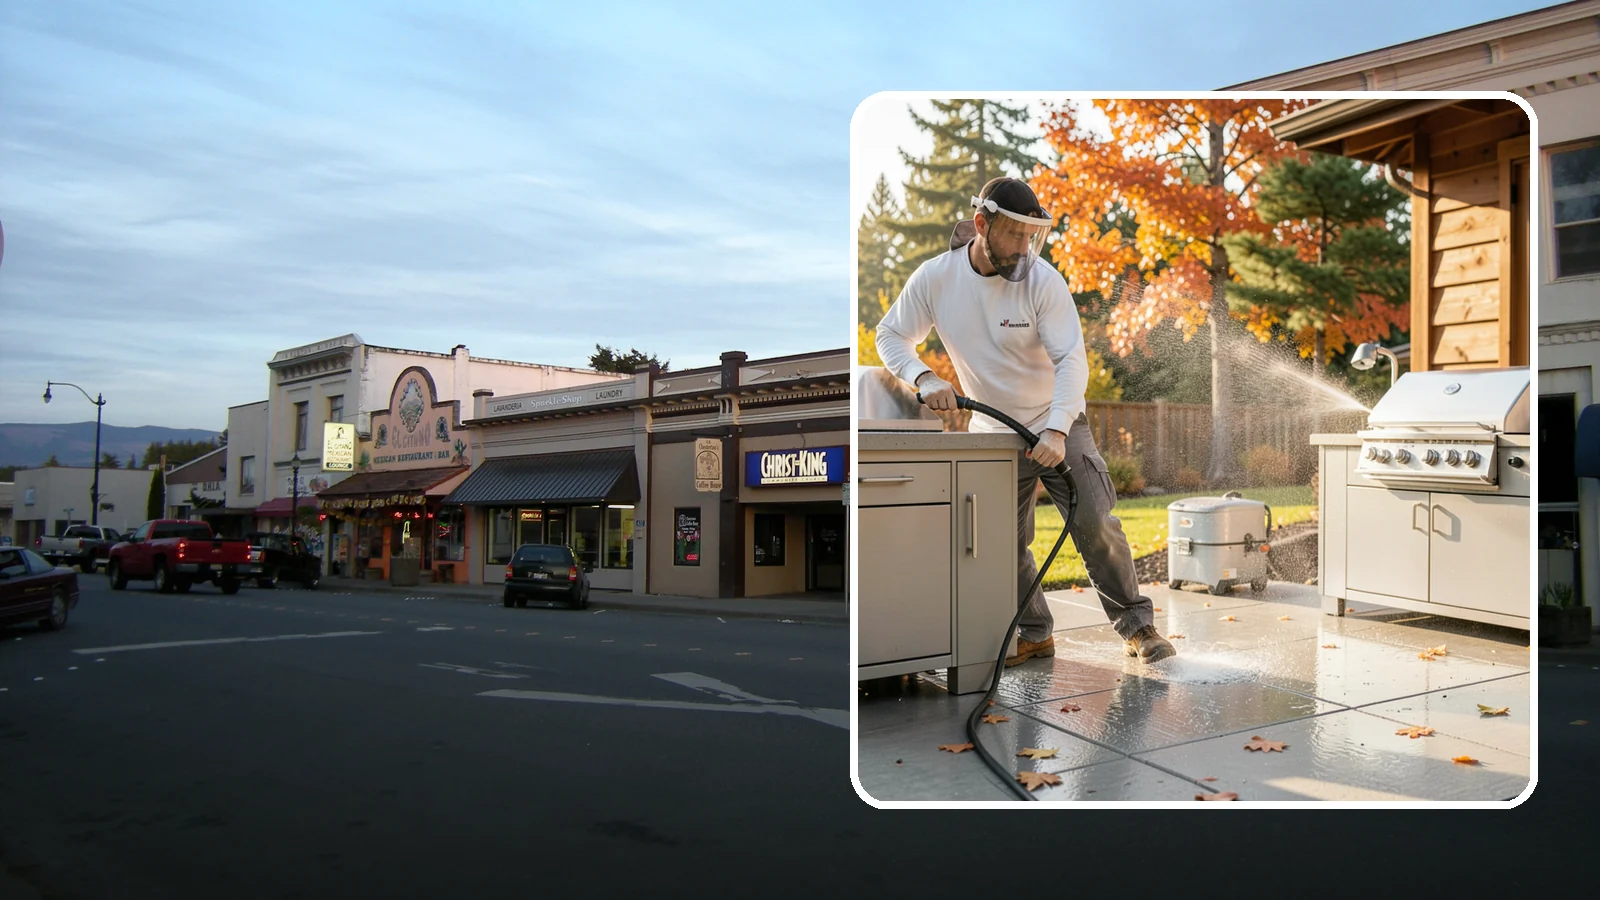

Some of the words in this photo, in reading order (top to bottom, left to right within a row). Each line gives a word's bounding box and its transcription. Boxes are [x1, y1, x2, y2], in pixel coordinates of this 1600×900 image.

[493, 402, 523, 413] LAVANDERIA
[561, 394, 582, 405] Shop
[595, 389, 623, 400] LAUNDRY
[391, 425, 402, 449] EL
[373, 454, 396, 464] MEXICAN
[397, 451, 433, 462] RESTAURANT
[437, 450, 450, 459] BAR
[761, 452, 797, 477] CHRIST
[800, 450, 827, 476] KING
